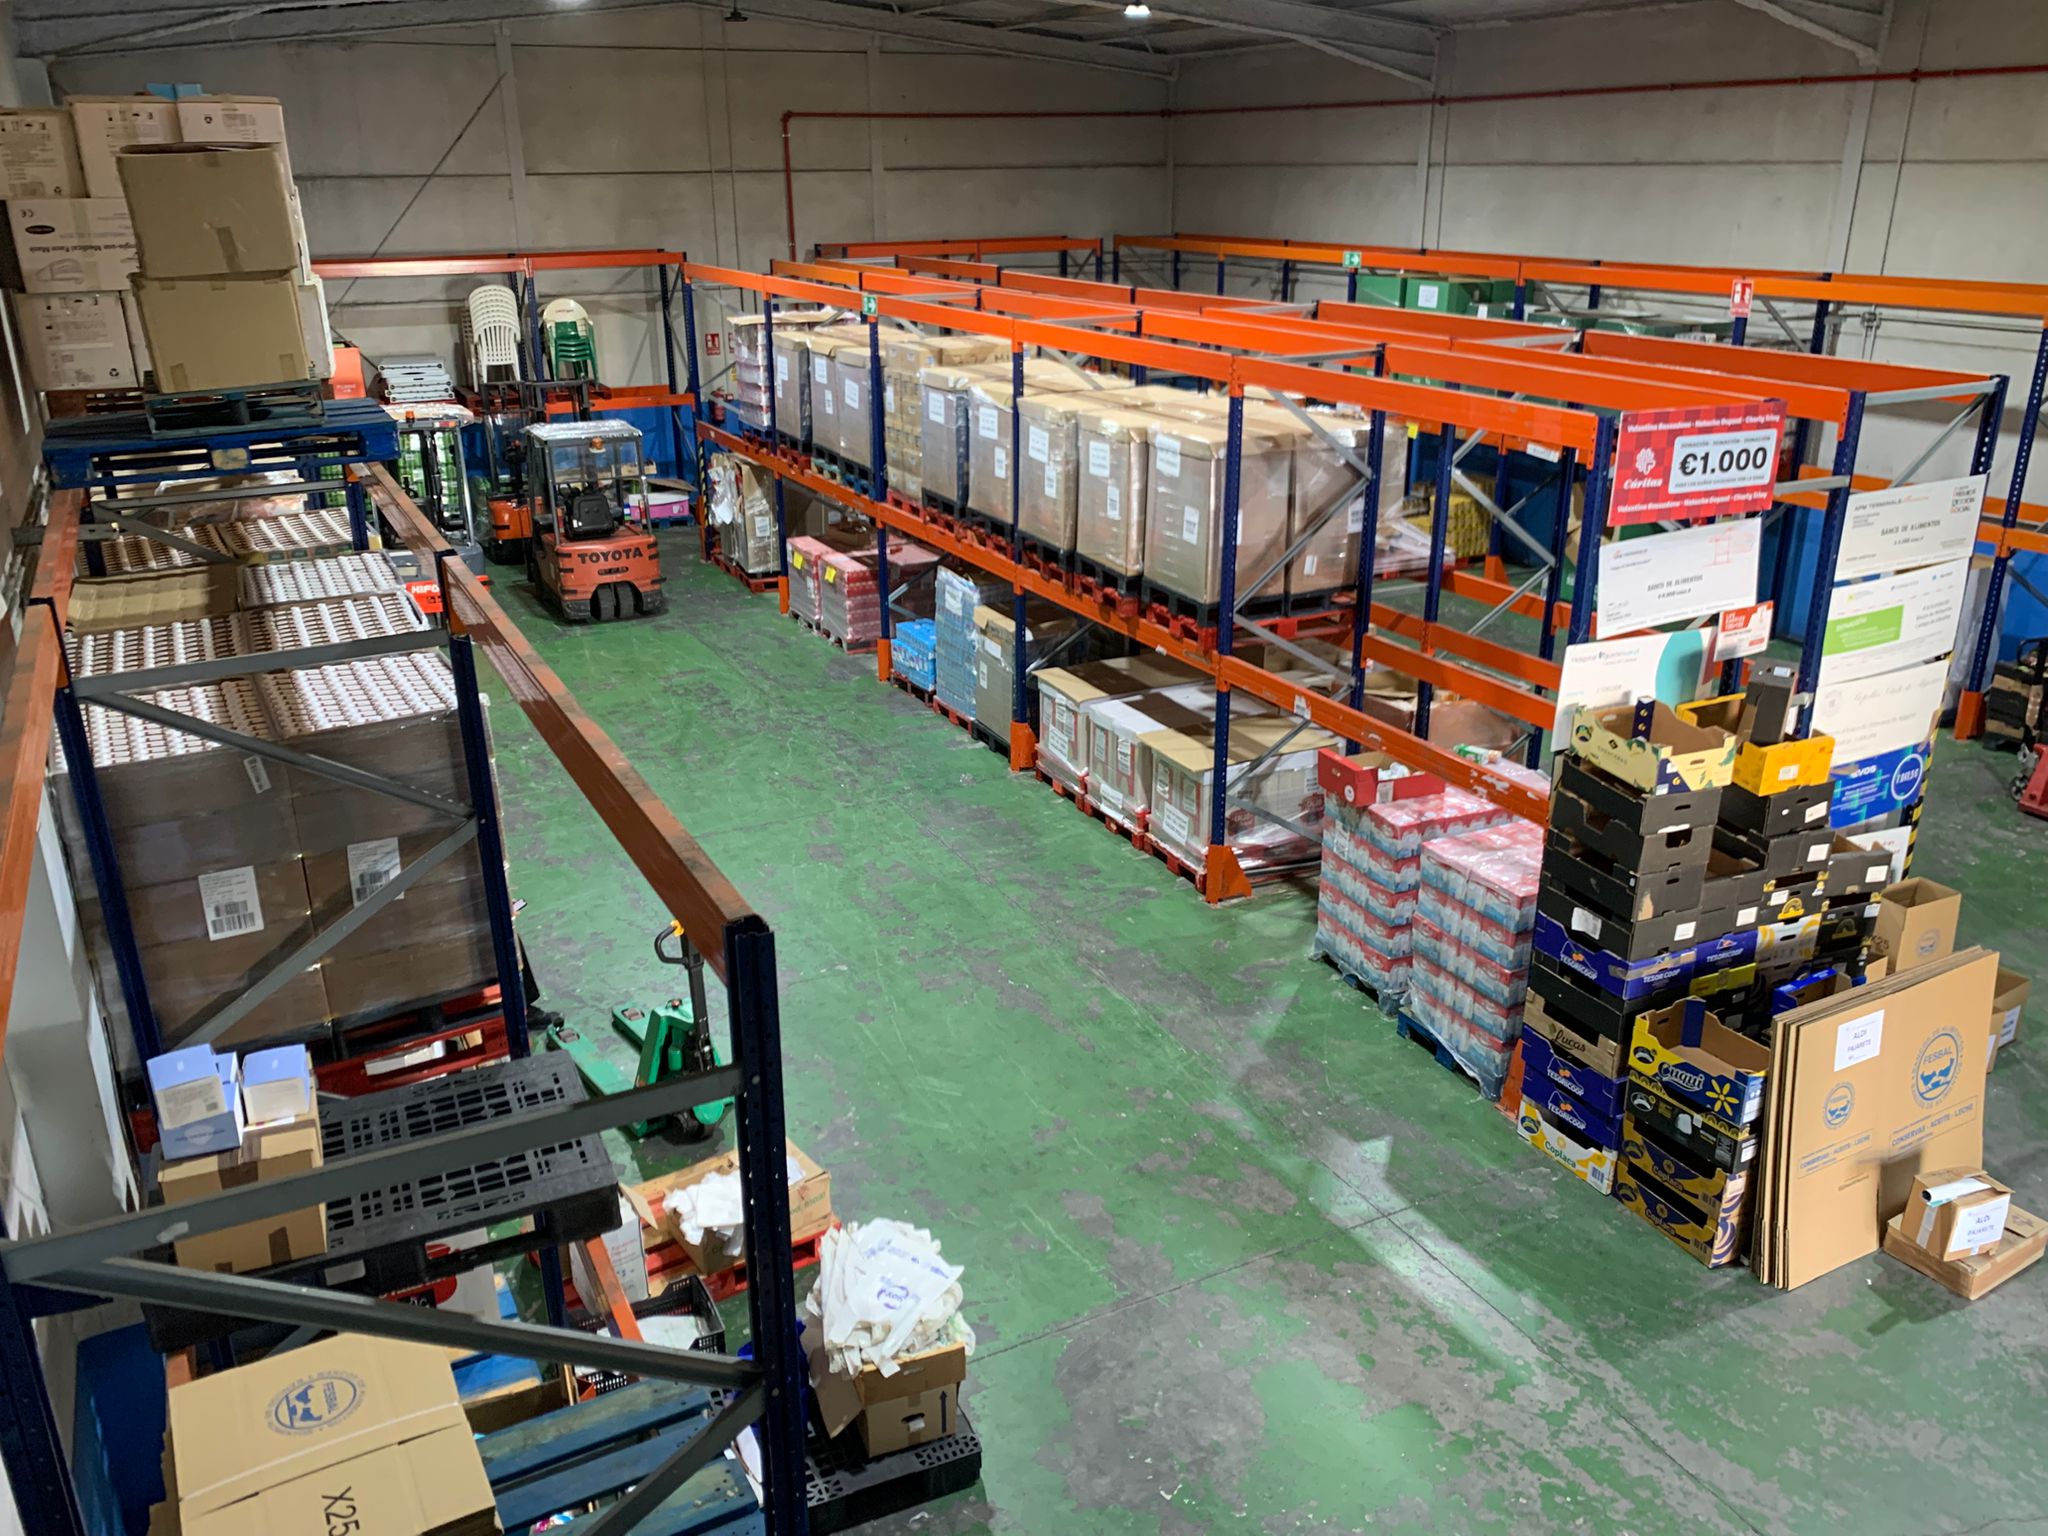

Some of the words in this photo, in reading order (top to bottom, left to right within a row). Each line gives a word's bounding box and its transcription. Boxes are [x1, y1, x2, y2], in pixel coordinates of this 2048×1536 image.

[1679, 447, 1768, 477] €1.000
[577, 547, 643, 564] TOYOTA
[1923, 1046, 1952, 1065] FESBAL
[1658, 1061, 1706, 1092] Cuqui
[1544, 1141, 1577, 1169] Coplaca
[1652, 1163, 1685, 1194] Coplaca
